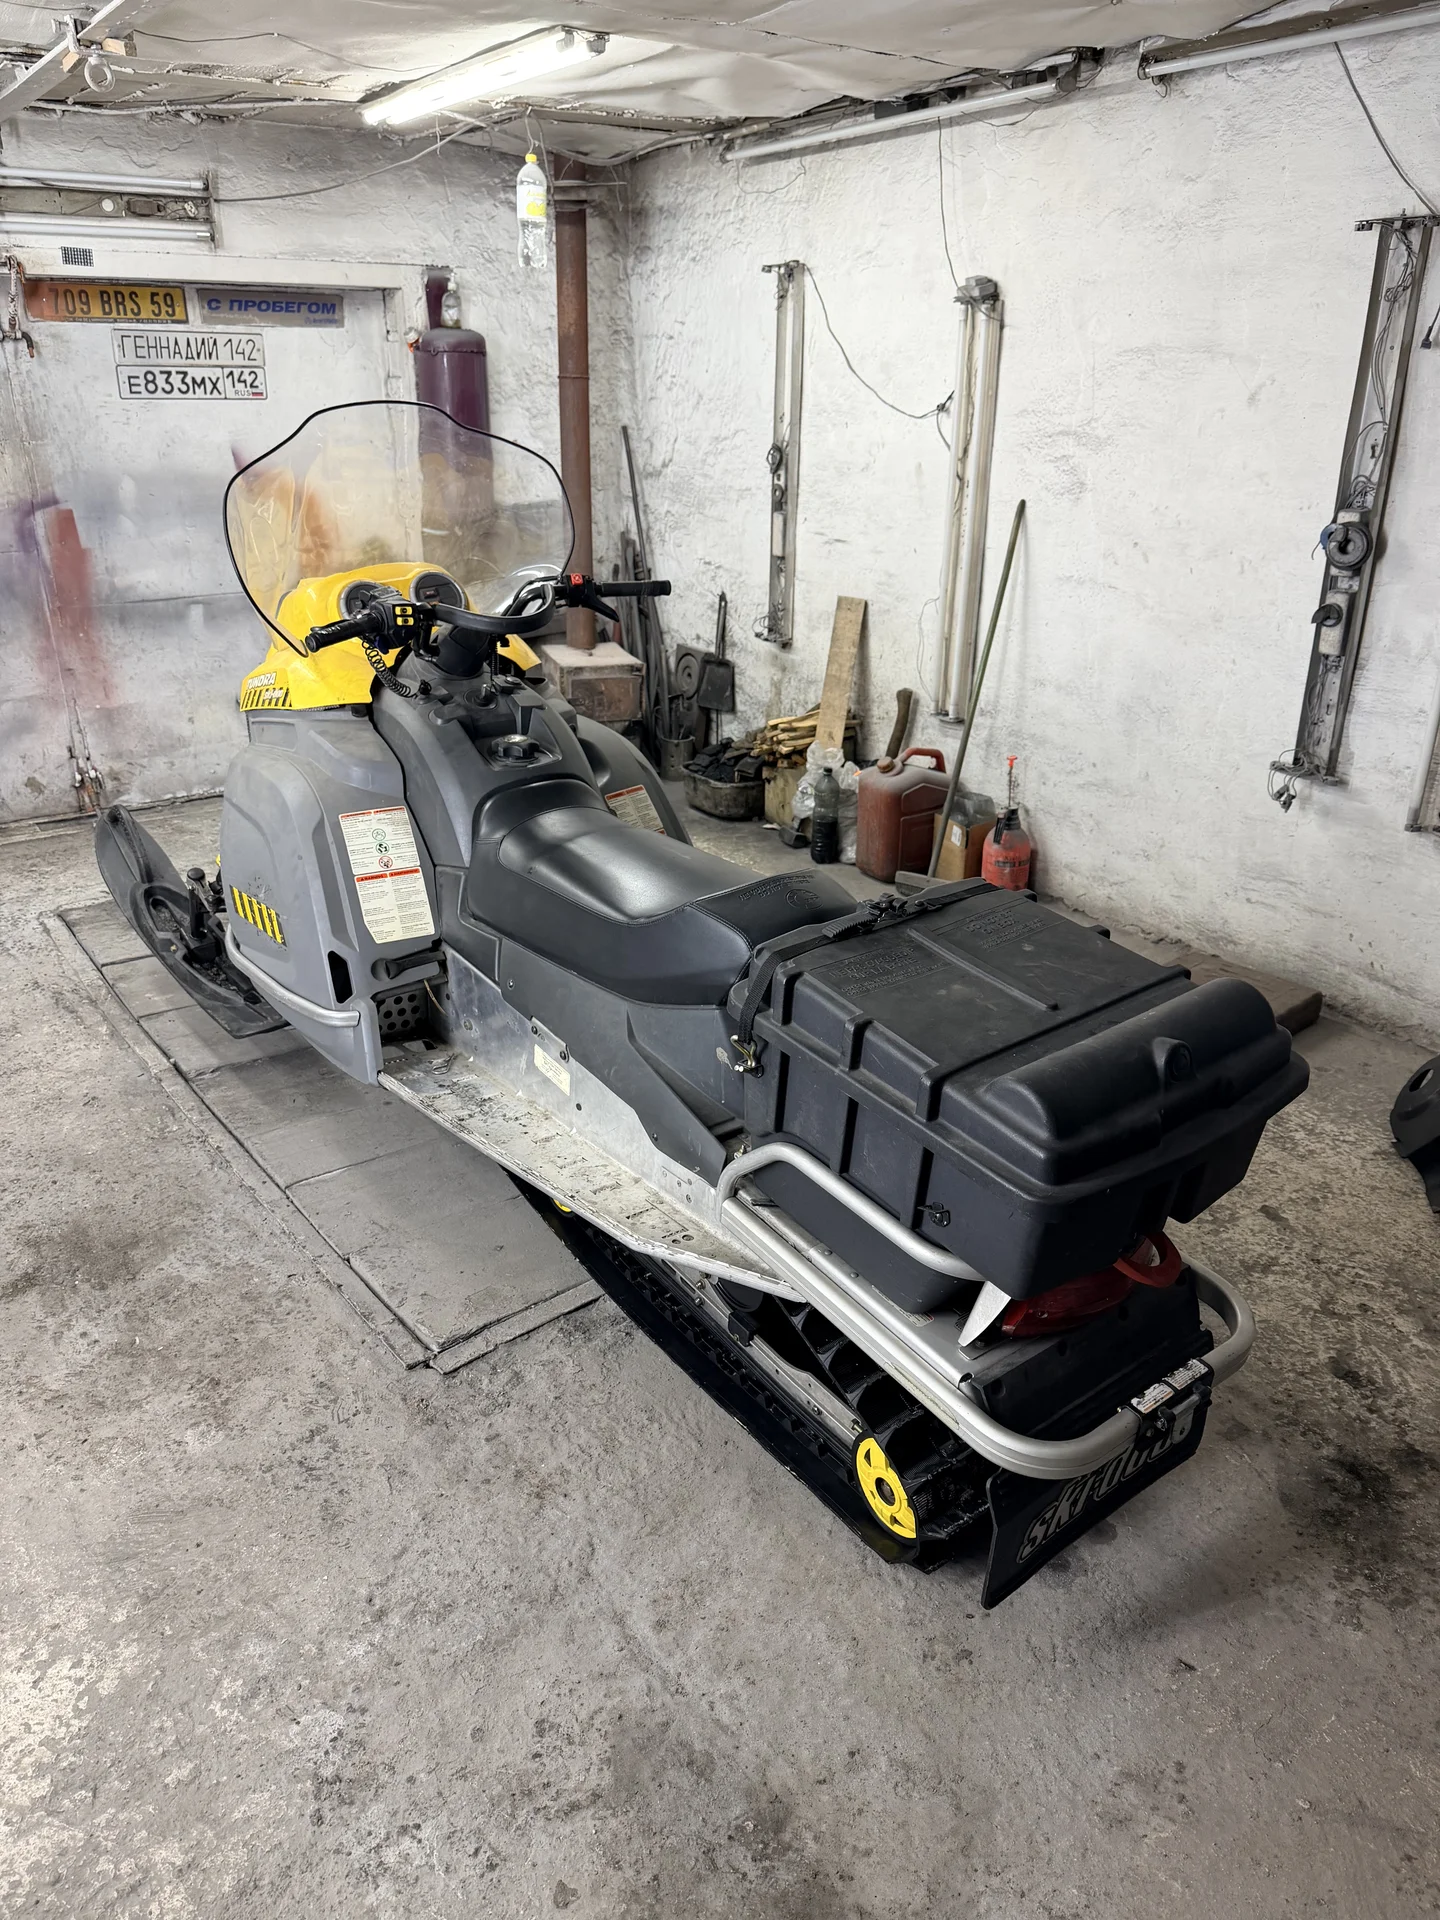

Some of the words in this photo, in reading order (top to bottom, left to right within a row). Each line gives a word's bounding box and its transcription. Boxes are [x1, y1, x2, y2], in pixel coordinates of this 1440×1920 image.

[48, 287, 92, 316] 709
[99, 290, 142, 317] BRS
[150, 291, 176, 318] 59
[206, 298, 221, 311] С
[228, 299, 337, 315] ПРОБЕГОМ
[120, 335, 219, 361] ГЕННАДИЙ
[223, 338, 257, 361] 142
[127, 370, 222, 395] Е833МХ
[226, 370, 259, 389] 142
[234, 389, 251, 397] RUS
[248, 672, 277, 689] TUNDRA
